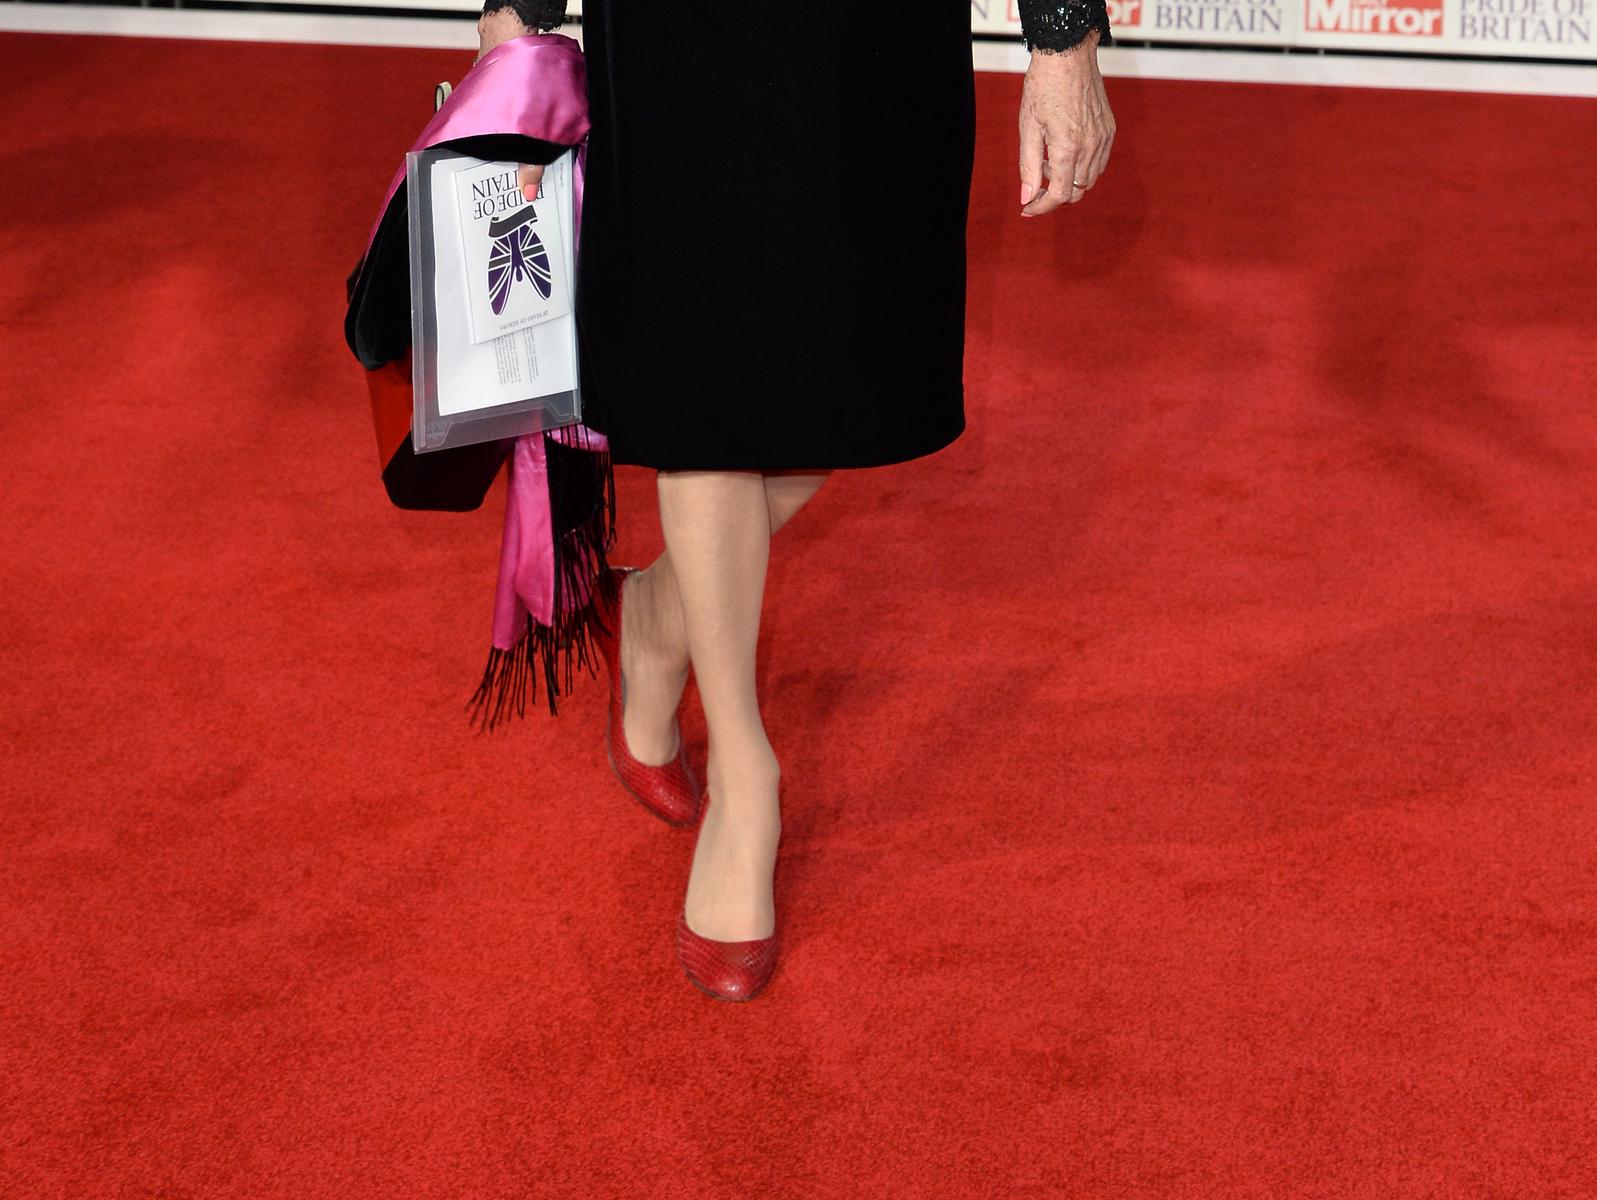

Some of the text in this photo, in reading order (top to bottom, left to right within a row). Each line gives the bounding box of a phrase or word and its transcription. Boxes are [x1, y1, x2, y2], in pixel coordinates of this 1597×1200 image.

[1155, 3, 1283, 33] BRITAIN
[1459, 15, 1592, 44] BRITAIN
[471, 169, 520, 201] ITAIN
[473, 182, 544, 221] PIDE OF
